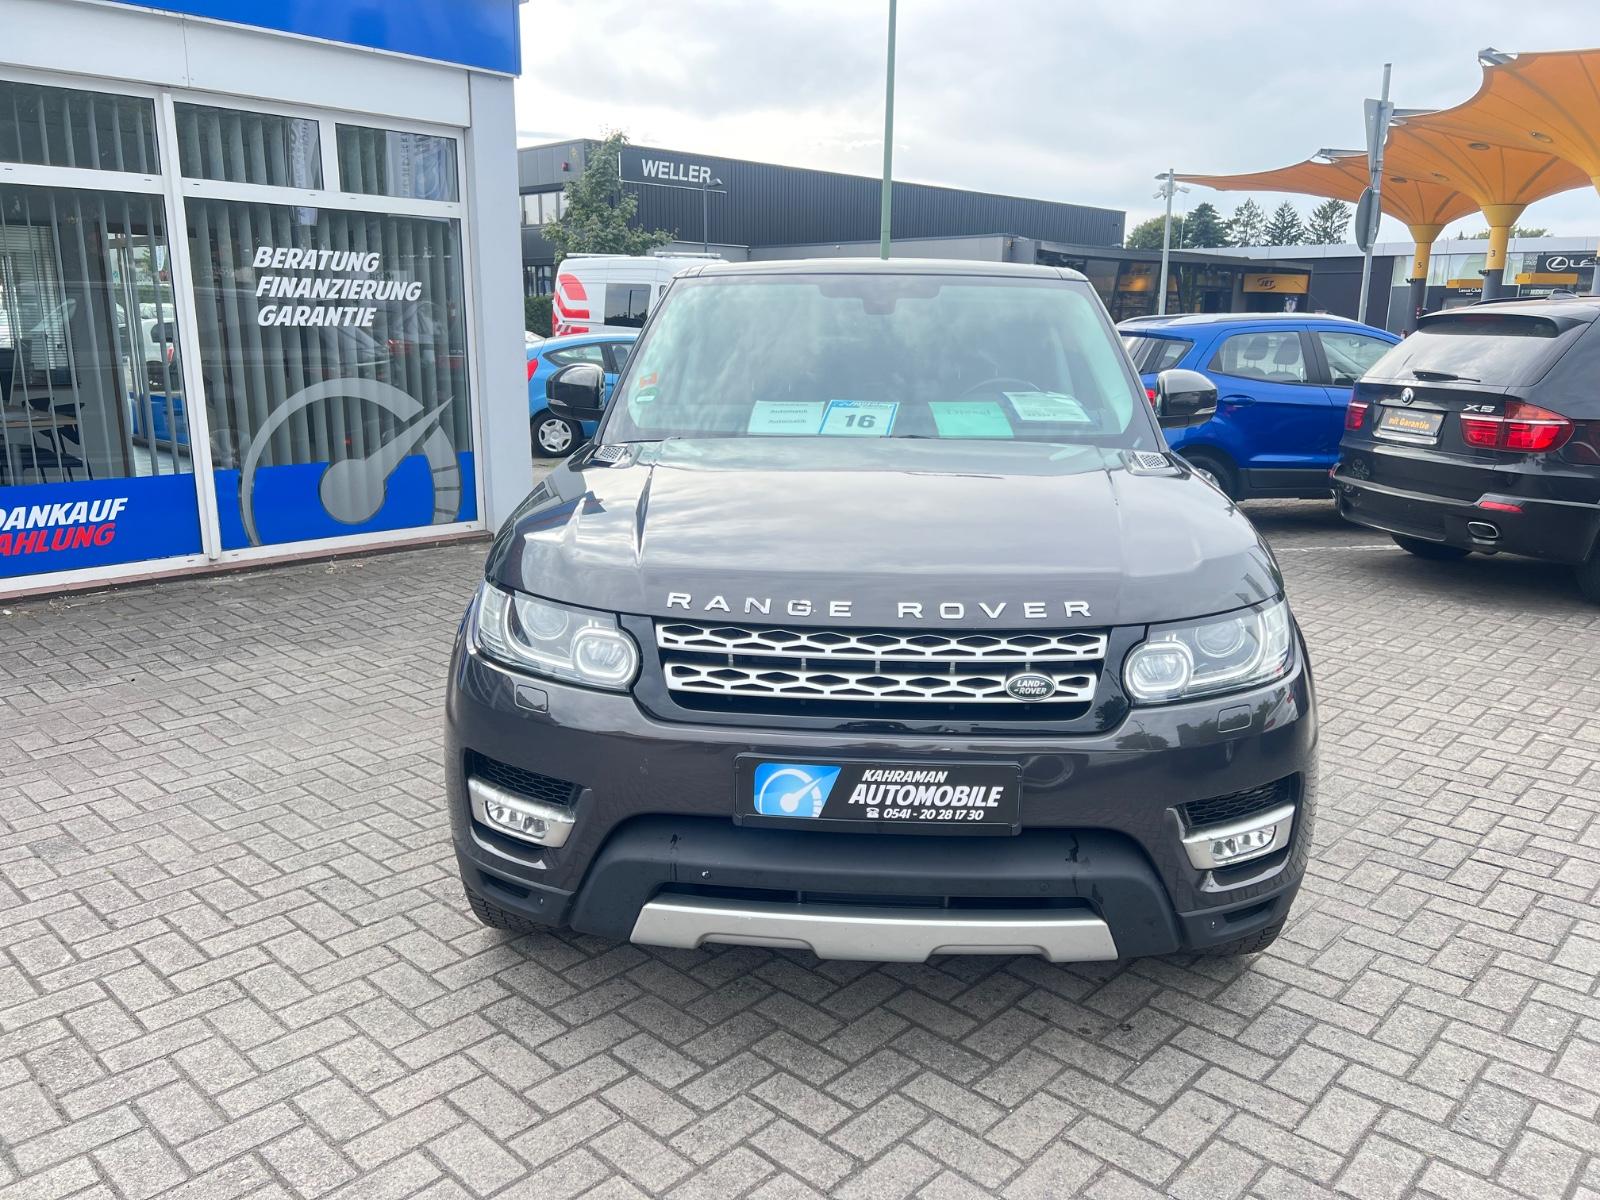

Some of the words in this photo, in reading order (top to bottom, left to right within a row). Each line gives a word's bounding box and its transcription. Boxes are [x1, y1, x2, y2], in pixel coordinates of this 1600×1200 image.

[641, 159, 711, 184] WELLER
[252, 246, 380, 273] BERATUNG
[1490, 249, 1496, 257] 3
[1418, 261, 1423, 269] 5
[255, 276, 422, 301] FINANZIERUNG
[257, 305, 377, 327] GARANTIE
[1463, 404, 1496, 413] X5
[845, 414, 877, 428] 16
[1399, 417, 1430, 430] Garantie
[666, 591, 852, 617] RANGE
[897, 601, 1092, 619] ROVER
[1017, 679, 1040, 688] LAND
[1018, 687, 1047, 695] ROVER
[862, 769, 948, 783] KAHRAMAN
[848, 783, 1004, 808] AUTOMOBILE
[883, 808, 912, 819] 0541
[919, 809, 936, 820] 20
[937, 809, 954, 820] 28
[954, 809, 967, 820] 17
[967, 809, 984, 821] 30
